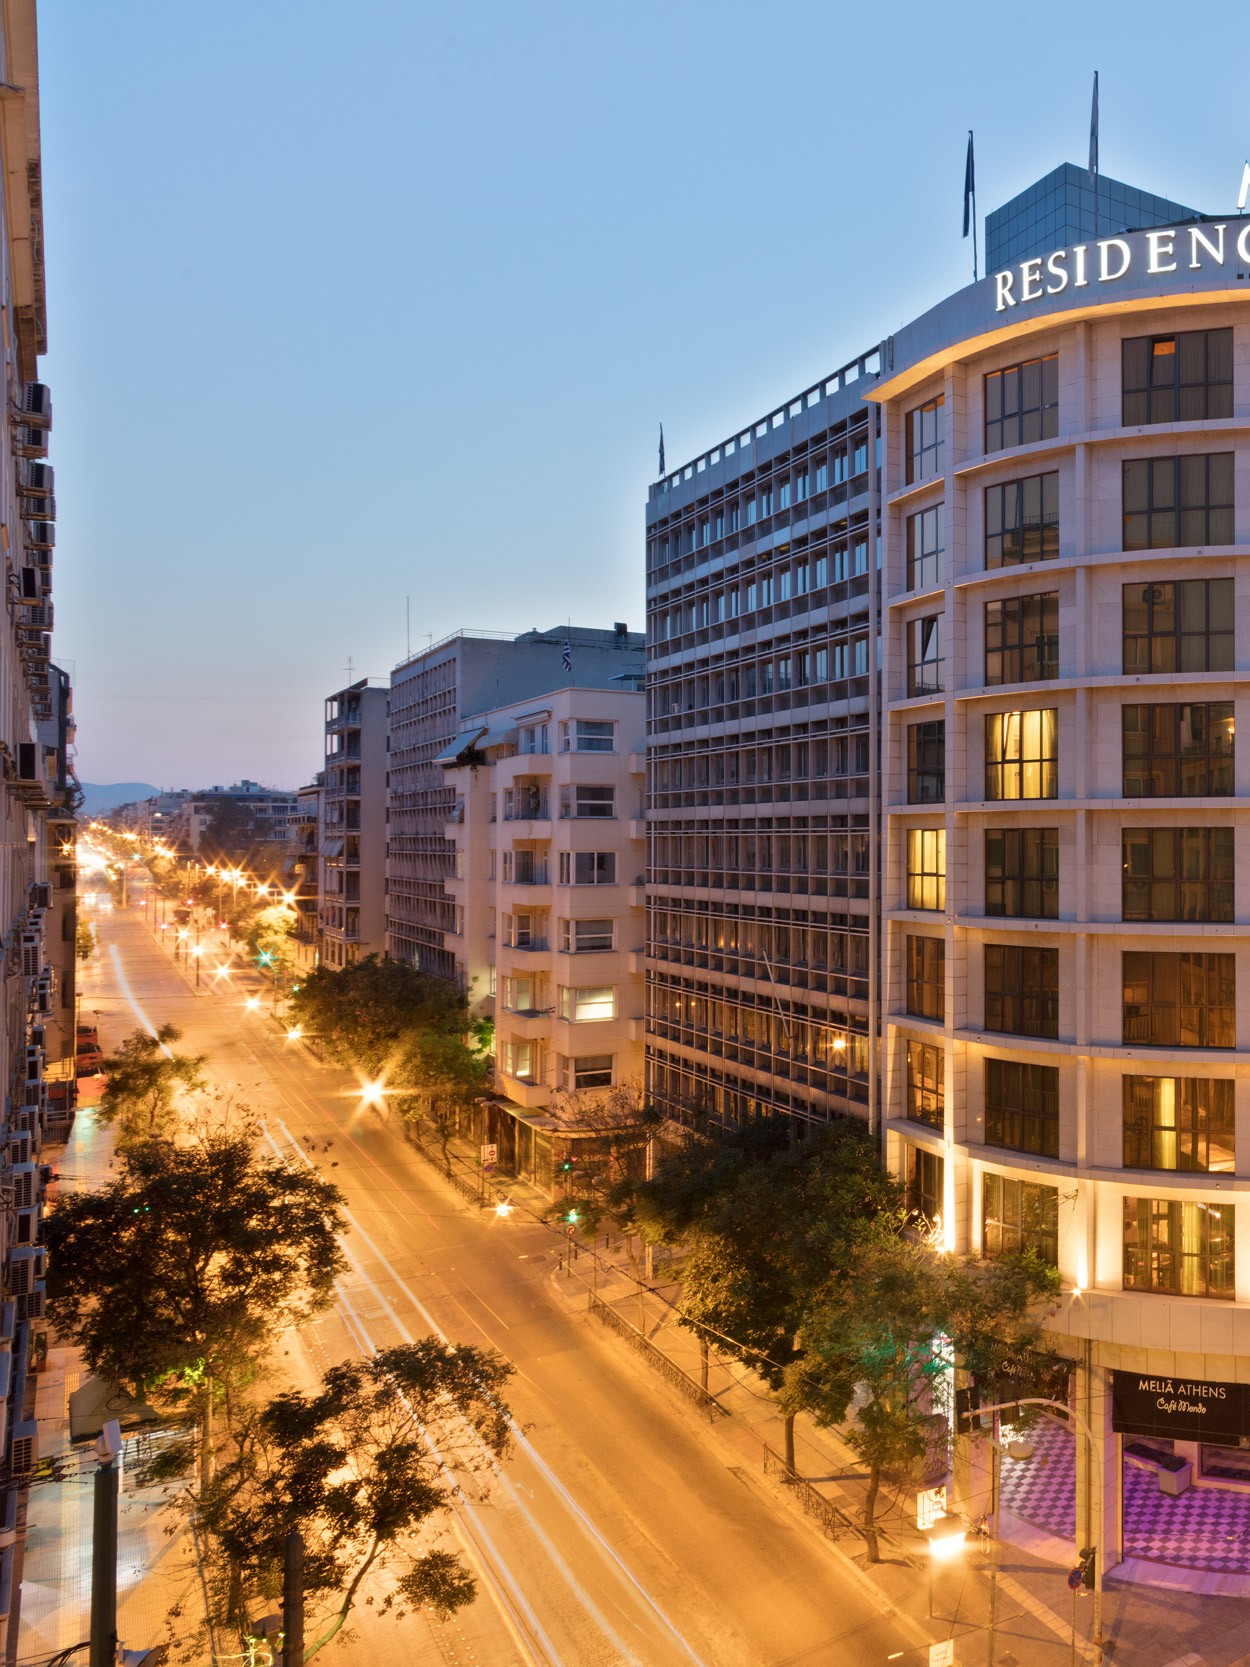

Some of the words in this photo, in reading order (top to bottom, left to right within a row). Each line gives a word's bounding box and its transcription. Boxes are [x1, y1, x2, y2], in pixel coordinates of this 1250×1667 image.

[1138, 1379, 1174, 1394] MELIÃ
[1177, 1383, 1227, 1399] ATHENS
[1156, 1397, 1177, 1413] Café
[1177, 1399, 1207, 1414] Mondo
